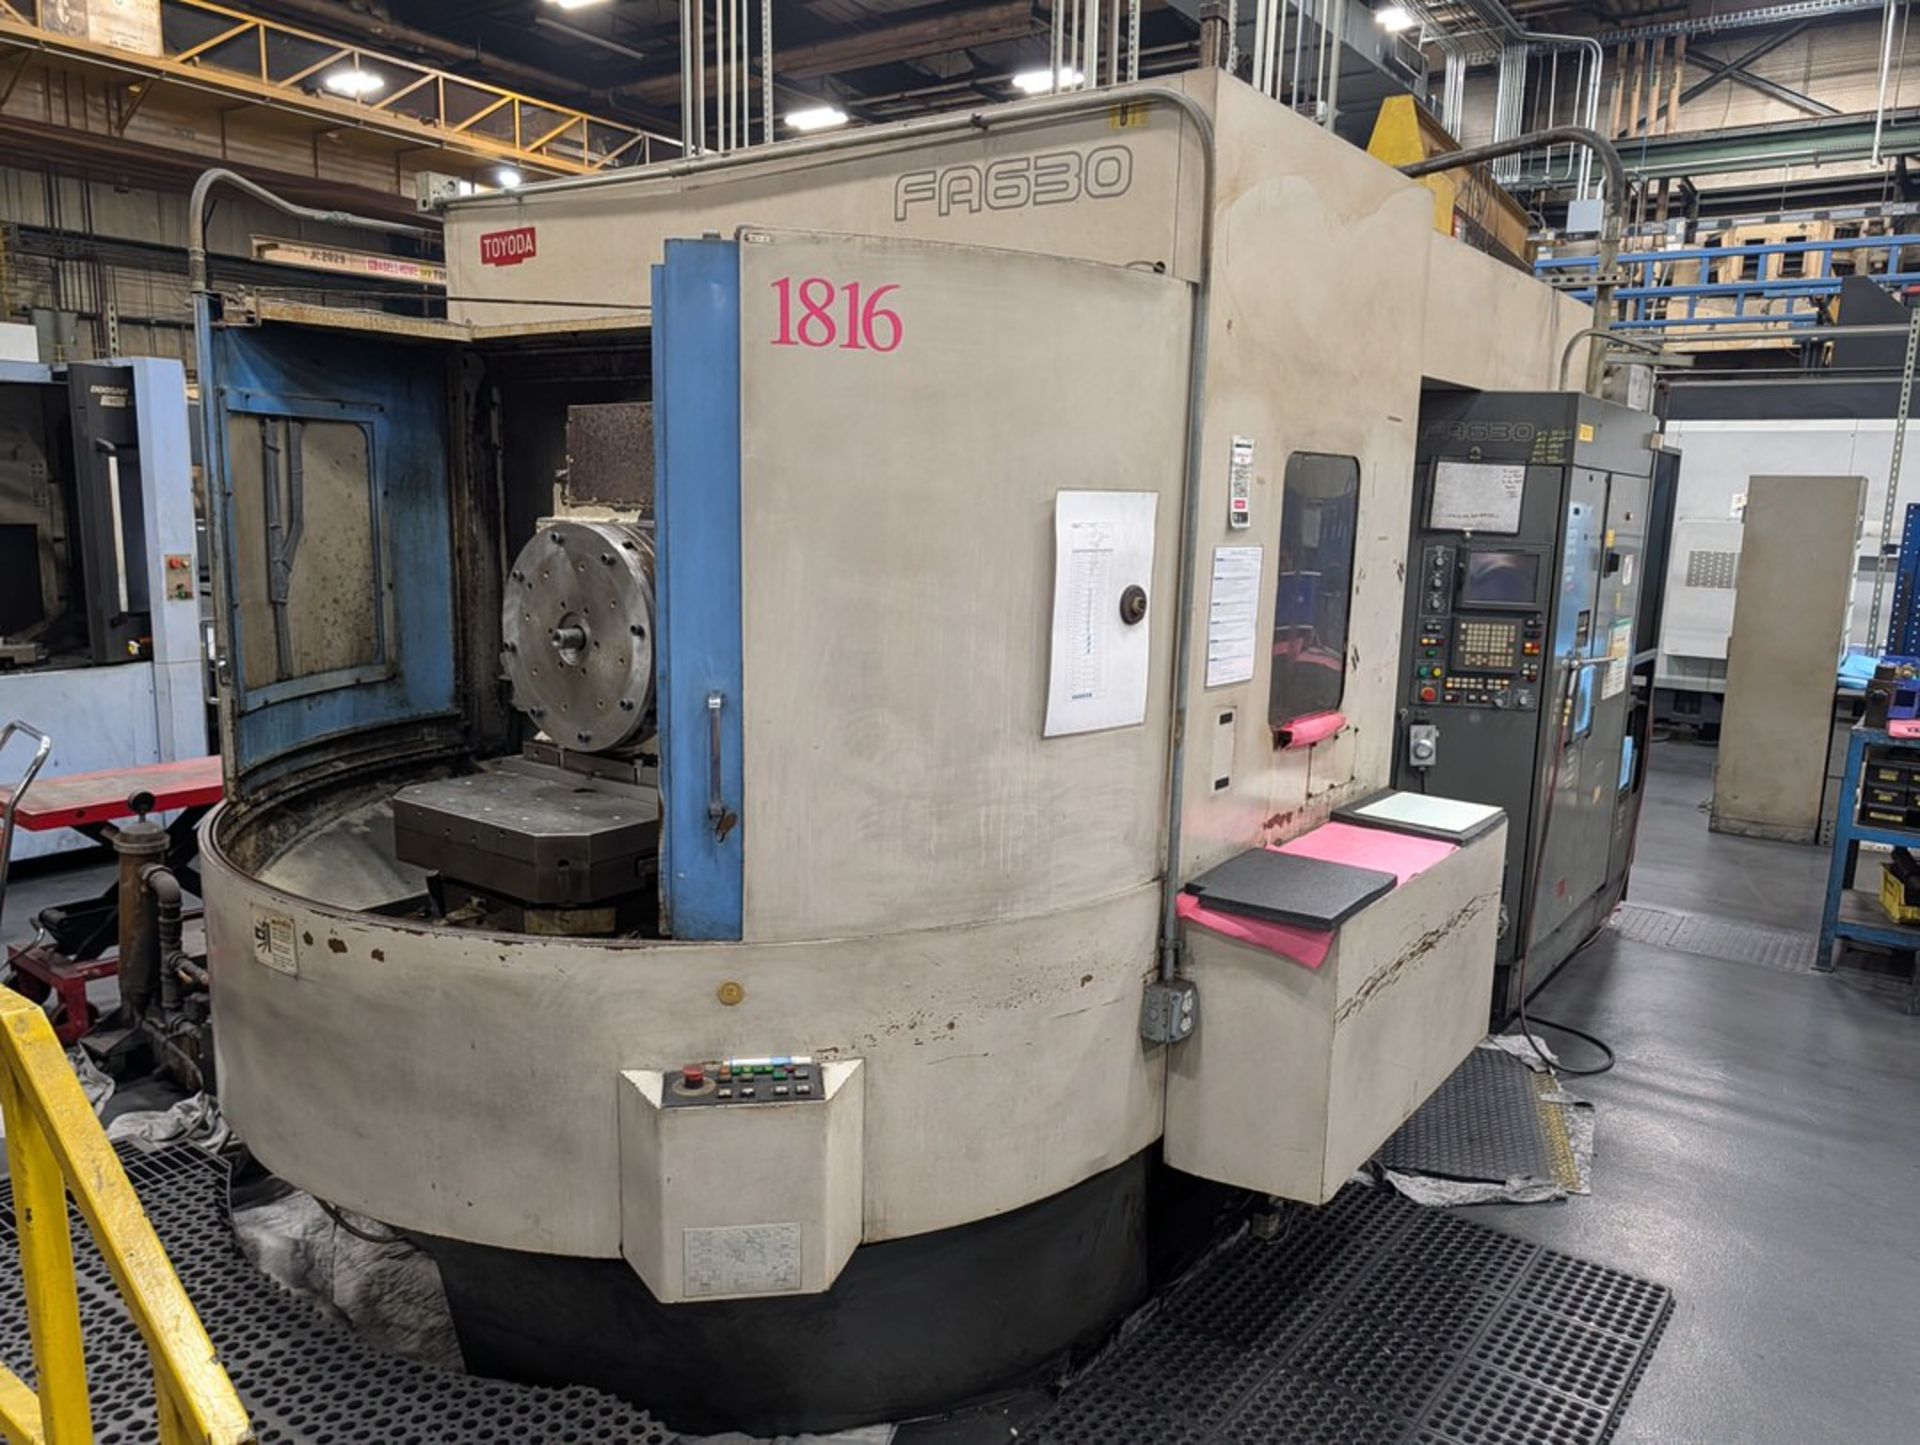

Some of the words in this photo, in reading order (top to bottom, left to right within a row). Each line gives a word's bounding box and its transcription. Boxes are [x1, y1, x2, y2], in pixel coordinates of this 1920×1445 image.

[894, 145, 1133, 222] FA630
[482, 233, 535, 258] TOYODA
[770, 276, 903, 353] 1816
[1422, 421, 1535, 443] FA630
